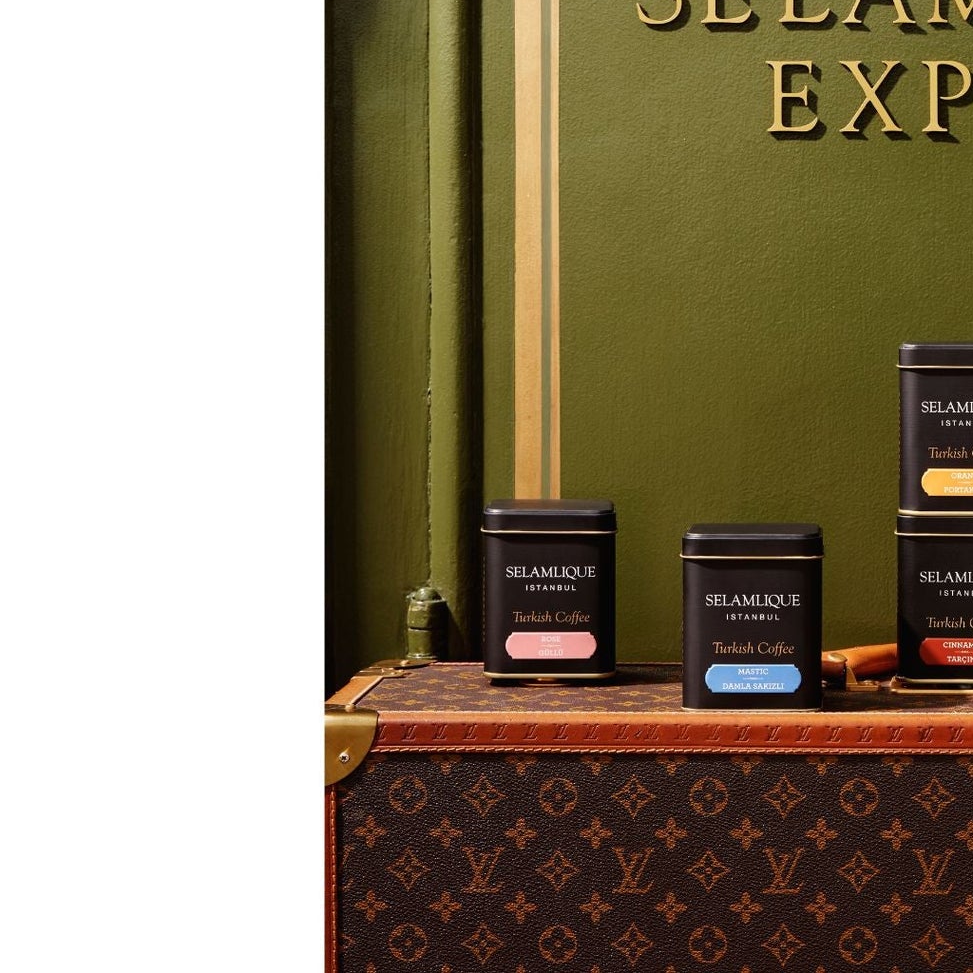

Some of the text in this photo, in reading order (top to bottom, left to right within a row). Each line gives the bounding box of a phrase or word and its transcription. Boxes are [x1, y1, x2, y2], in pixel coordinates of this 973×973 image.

[928, 446, 968, 459] Turkish
[505, 565, 596, 581] SELAMLIQUE
[705, 594, 801, 609] SELAMLIQUE
[512, 610, 590, 625] Turkish Coffee
[726, 613, 780, 621] ISTANBUL
[925, 616, 966, 629] Turkish
[540, 635, 562, 643] ROSE
[712, 641, 795, 657] Turkish Coffee
[722, 682, 784, 690] DAMLA SAKIZLI
